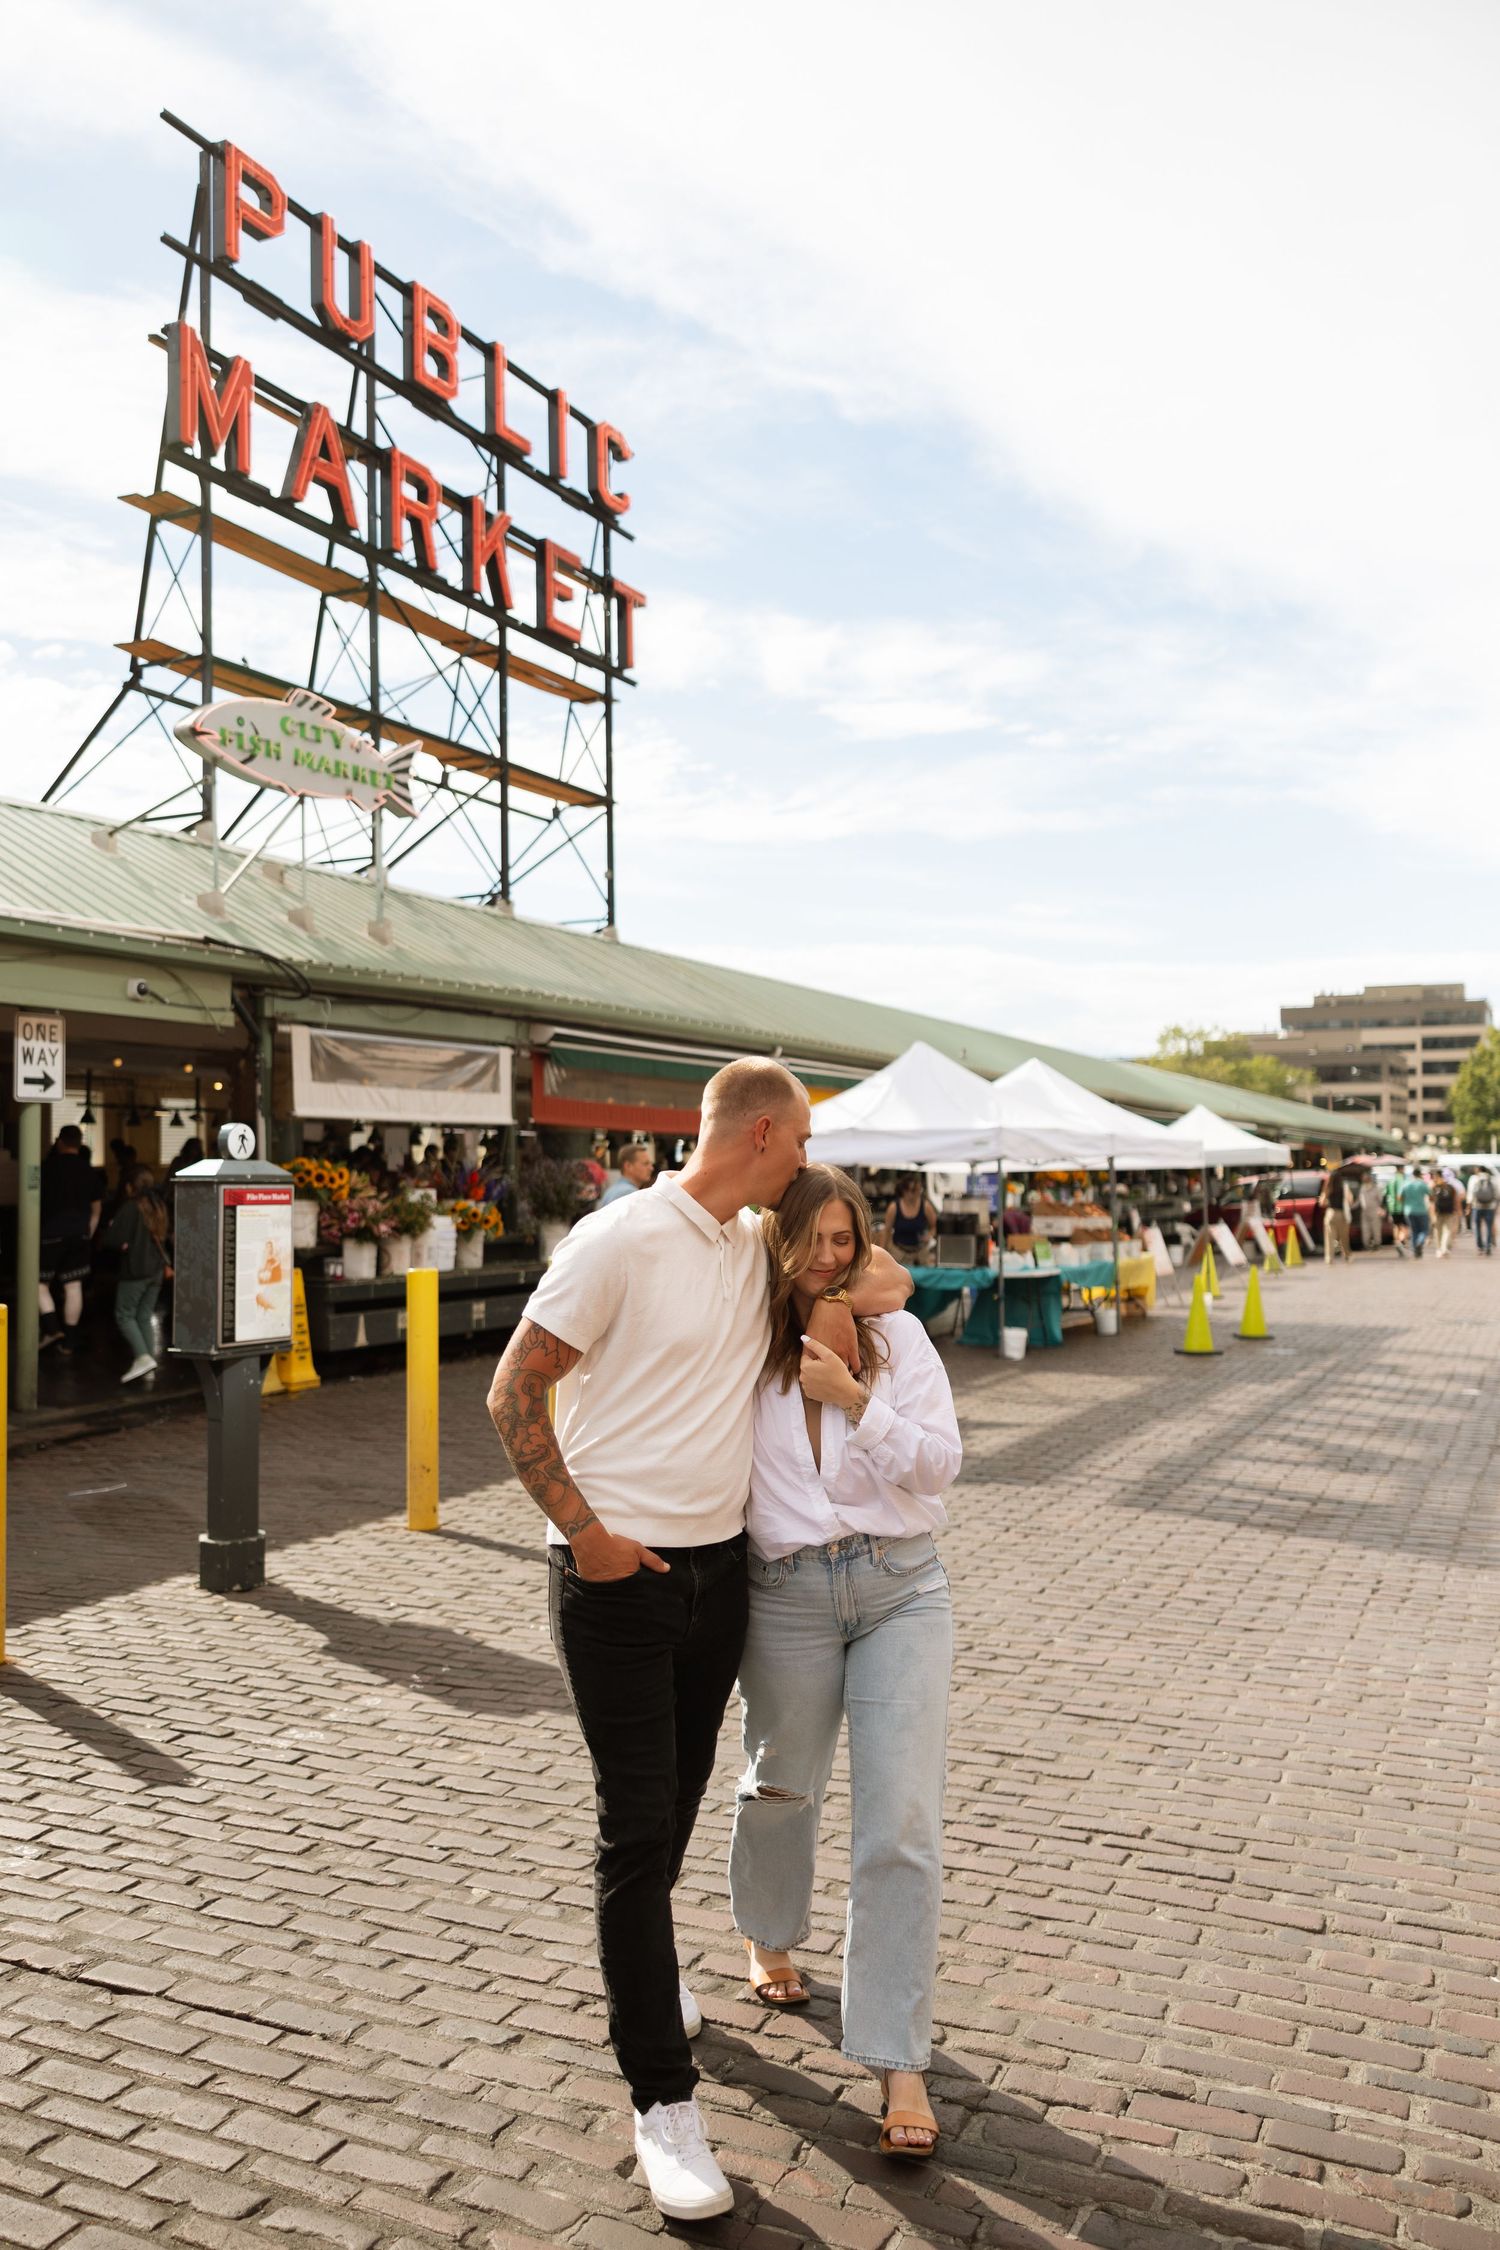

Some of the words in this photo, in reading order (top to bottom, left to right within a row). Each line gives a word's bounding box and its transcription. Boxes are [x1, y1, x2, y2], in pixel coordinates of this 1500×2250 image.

[212, 140, 634, 515] PUBLIC
[166, 320, 647, 669] MARKET
[279, 715, 346, 750] CITY
[219, 726, 282, 761] FISH
[293, 747, 396, 791] MARKET
[22, 1021, 59, 1043] ONE
[22, 1046, 60, 1067] WAY
